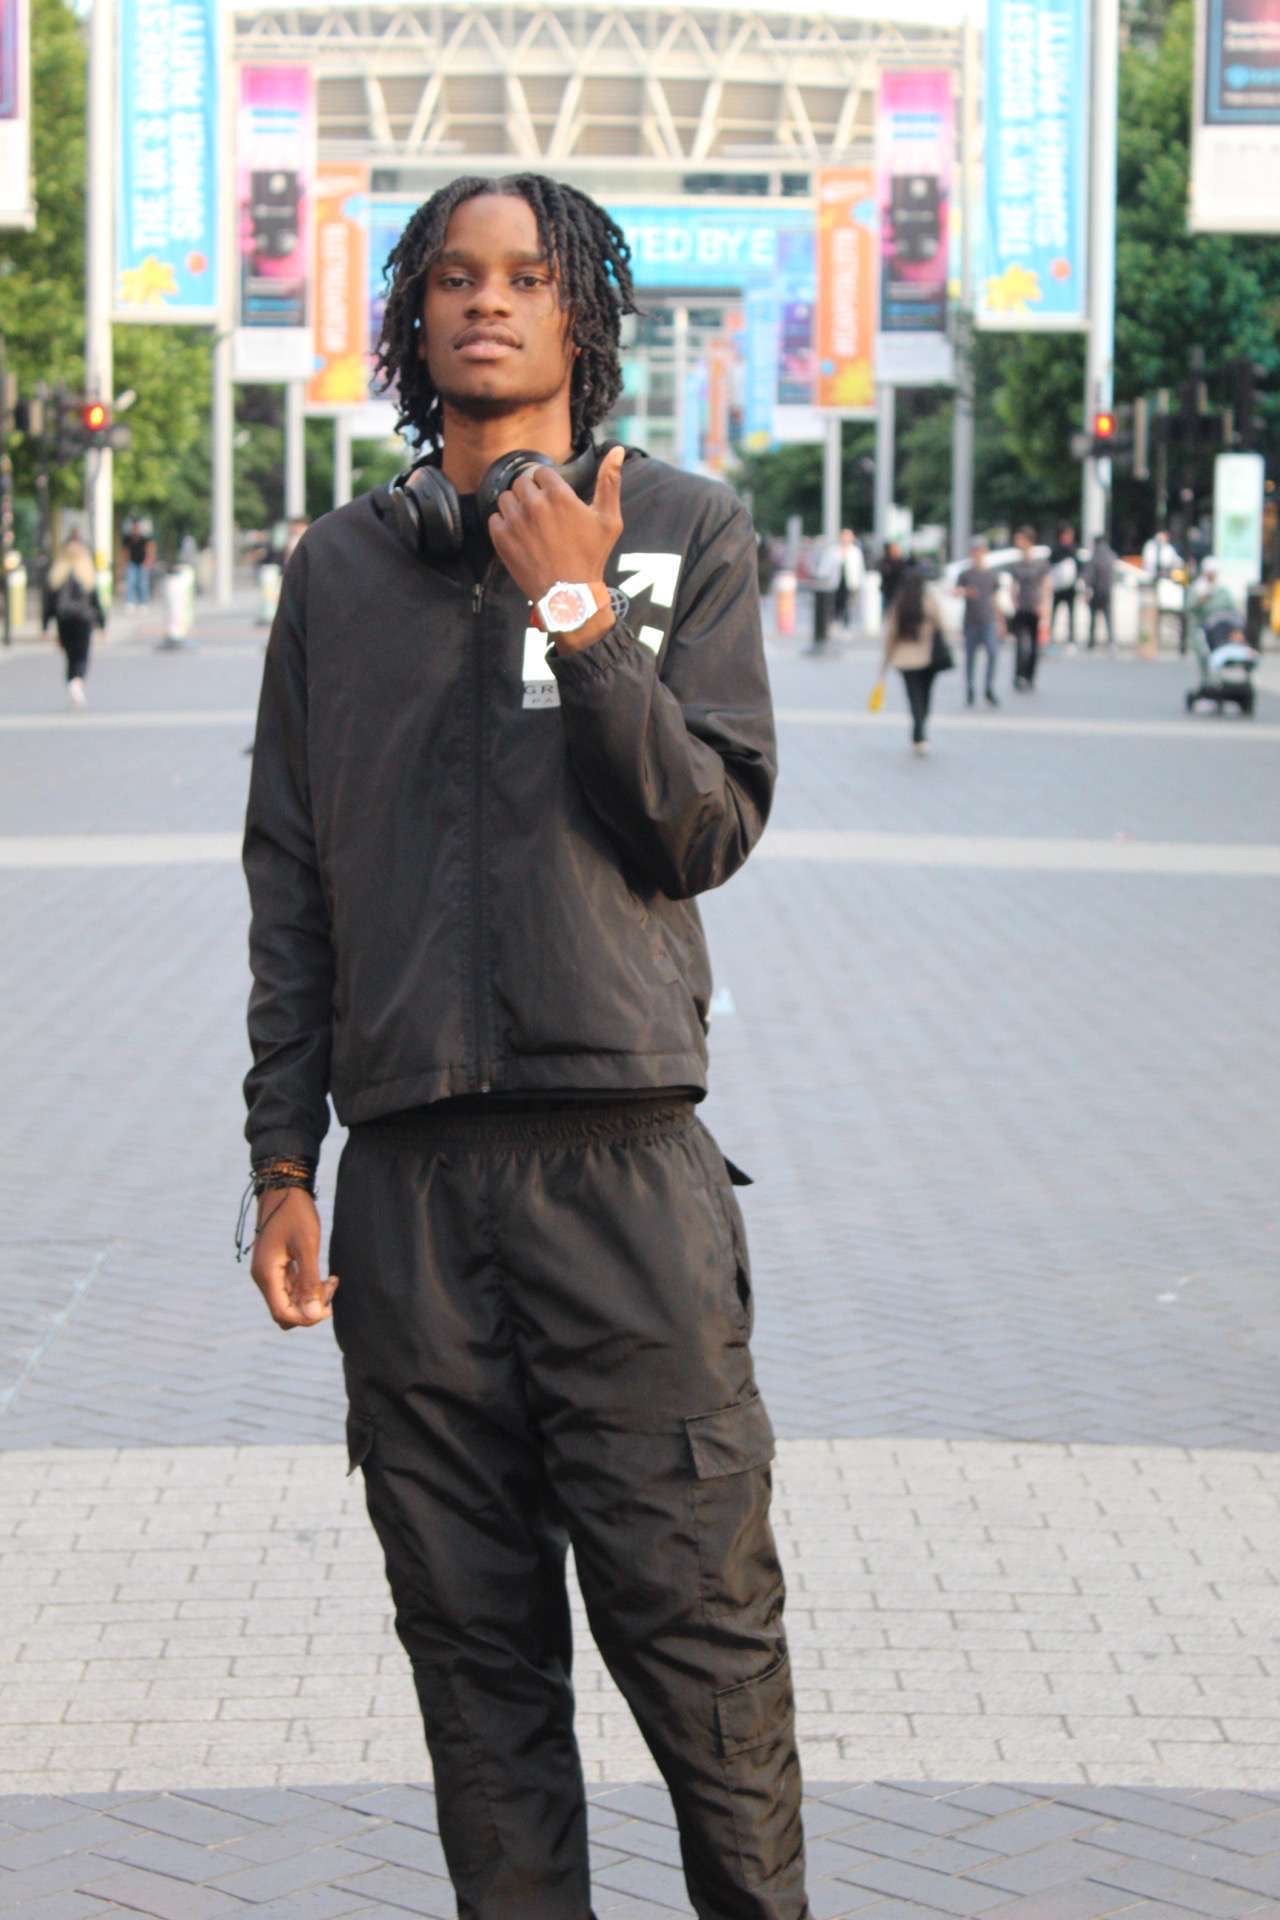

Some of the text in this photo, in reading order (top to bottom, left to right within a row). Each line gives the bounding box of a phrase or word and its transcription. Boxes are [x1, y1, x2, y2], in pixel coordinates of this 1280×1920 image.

[626, 228, 692, 263] TED
[699, 228, 747, 264] BY
[523, 684, 554, 695] GR
